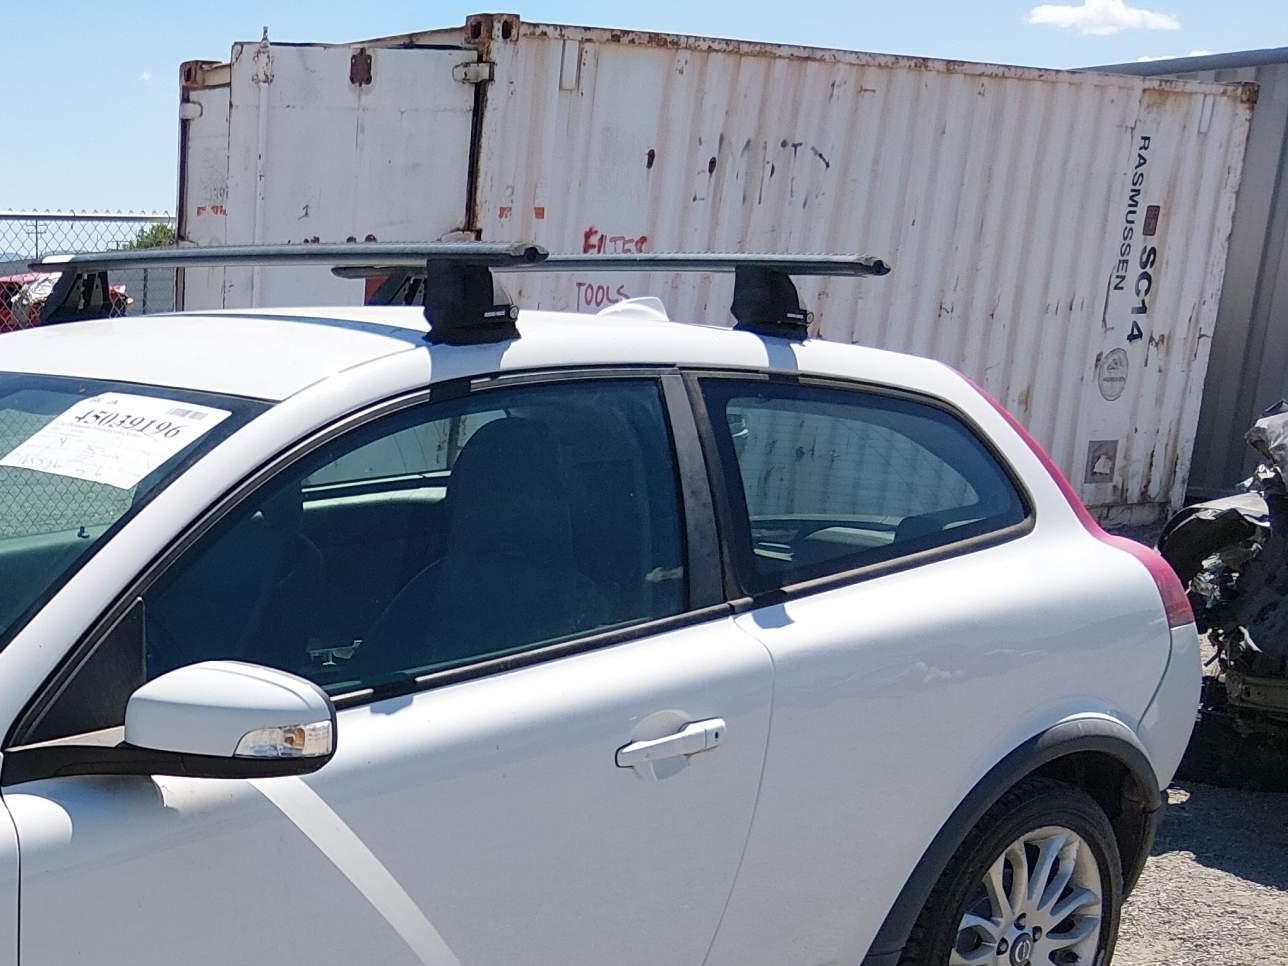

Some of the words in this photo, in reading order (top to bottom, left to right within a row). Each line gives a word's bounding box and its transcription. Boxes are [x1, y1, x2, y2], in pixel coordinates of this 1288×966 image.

[1113, 135, 1150, 291] RASMUSSEN
[576, 282, 631, 312] TOOLS
[74, 408, 182, 439] 45039196
